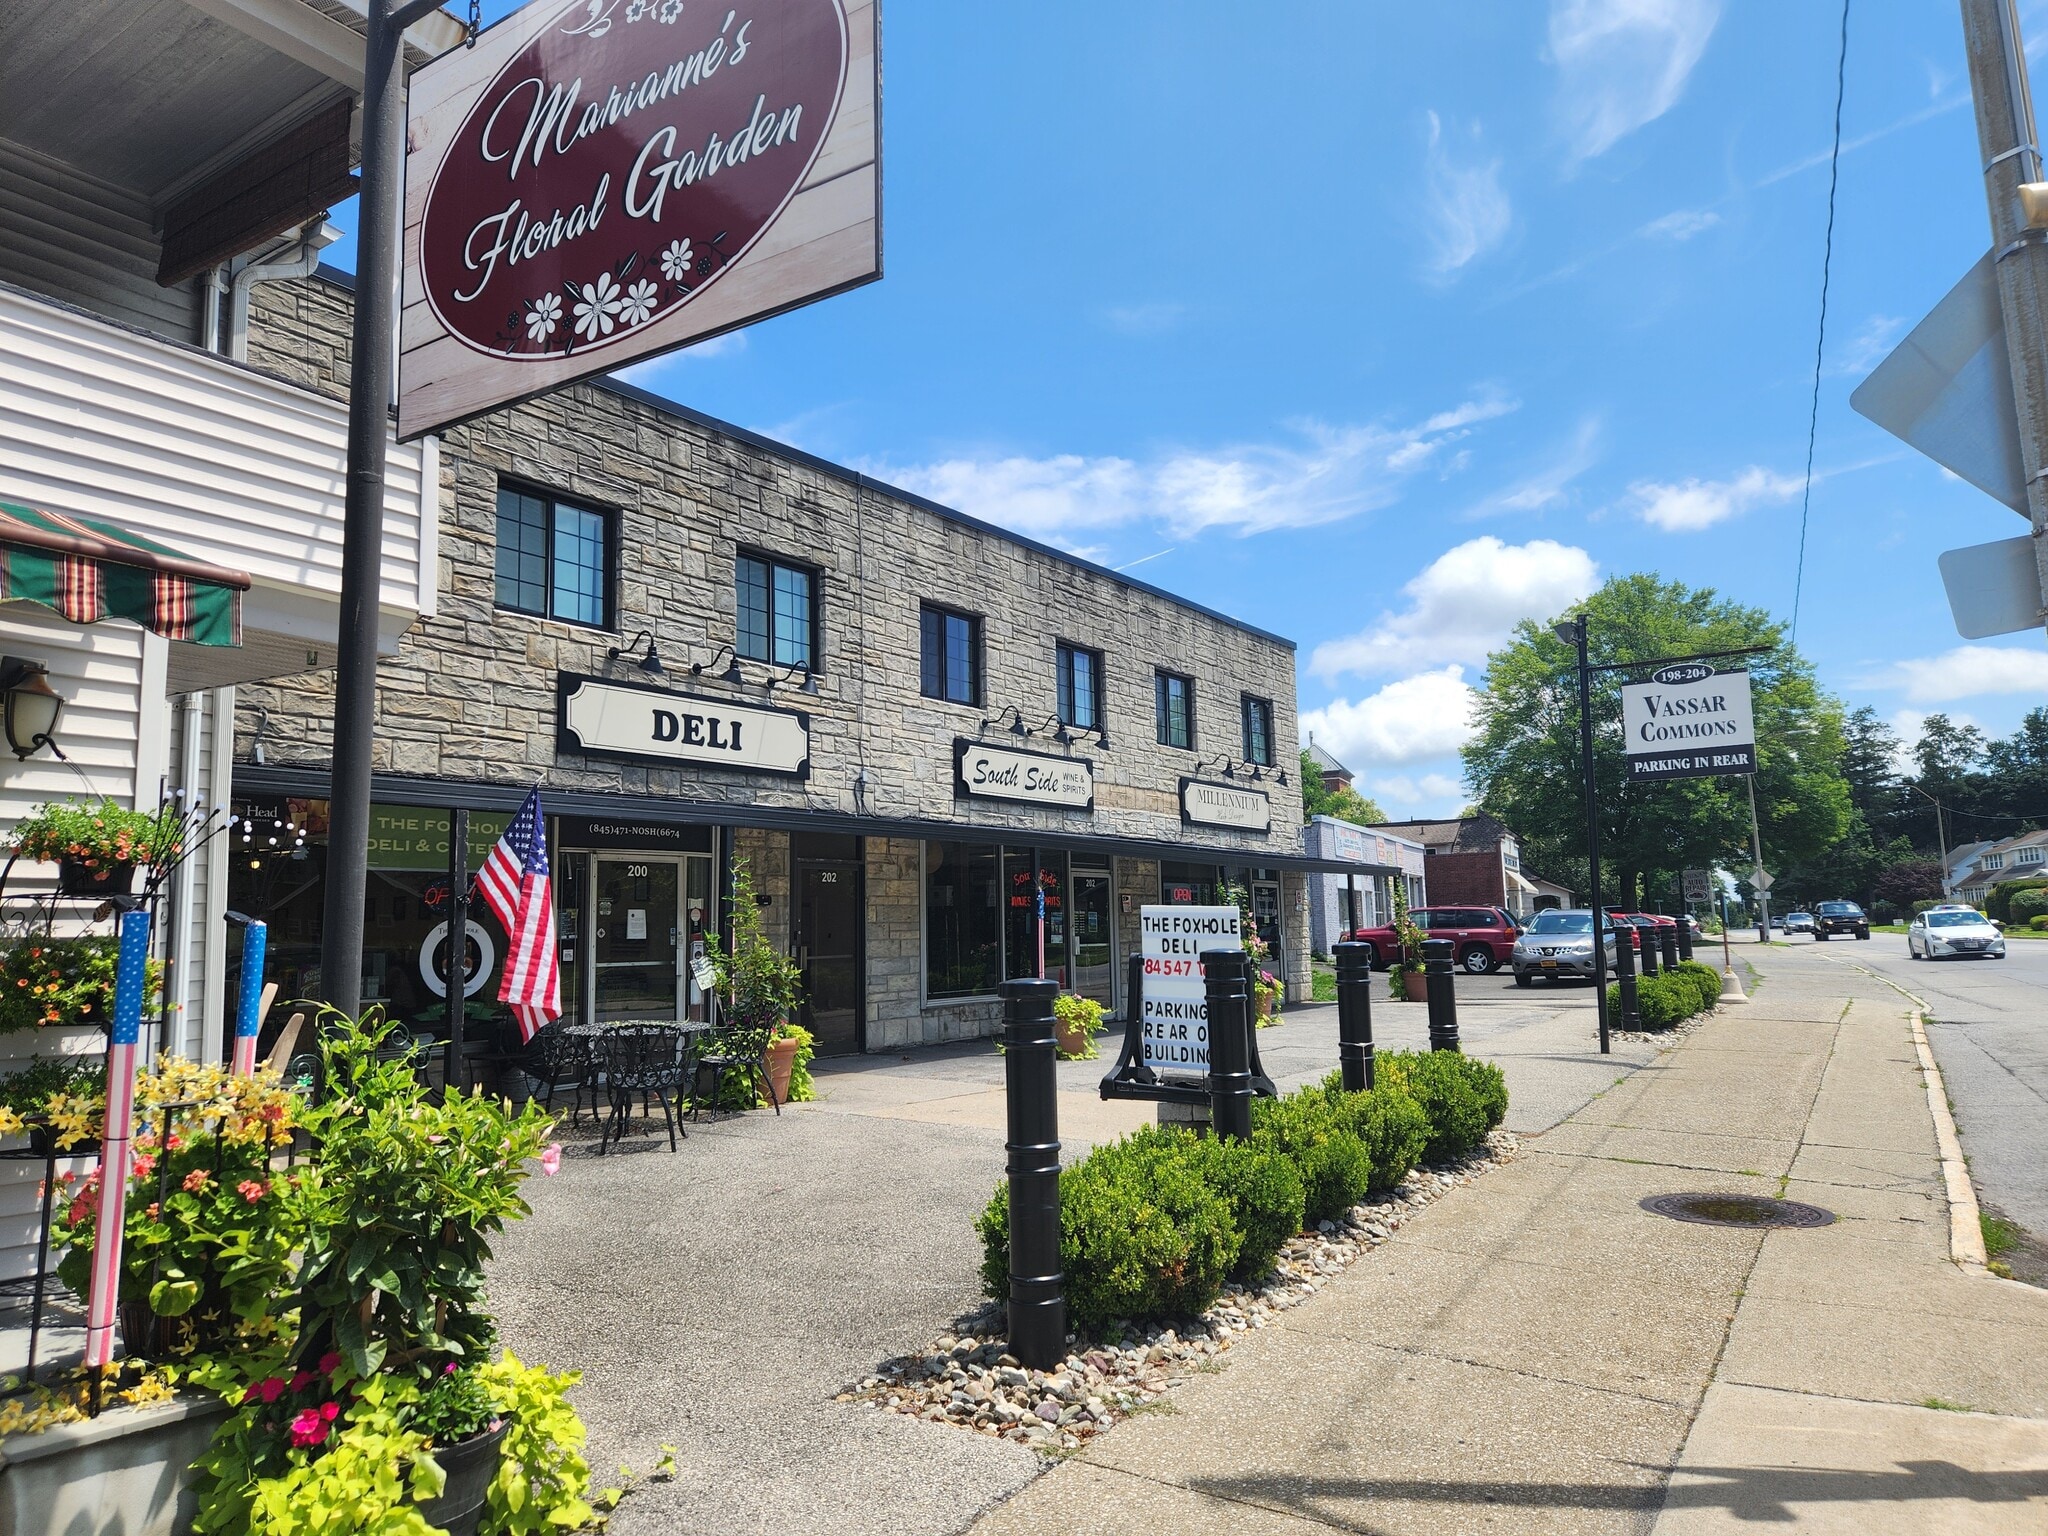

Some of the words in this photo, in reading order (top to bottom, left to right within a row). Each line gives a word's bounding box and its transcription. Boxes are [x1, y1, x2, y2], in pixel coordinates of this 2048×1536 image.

[481, 11, 752, 179] Marianne's
[454, 174, 610, 302] Floral
[625, 94, 803, 222] Garden
[1661, 667, 1707, 682] 198-204
[652, 709, 742, 751] DELI
[1634, 758, 1691, 773] PARKING
[1695, 757, 1709, 768] IN
[1713, 753, 1749, 767] REAR
[973, 759, 1019, 787] South
[1024, 767, 1059, 792] Side
[1062, 772, 1079, 783] WINE
[1080, 775, 1085, 783] &
[1062, 784, 1086, 795] SPIRITS
[1198, 789, 1259, 811] MILLENNIUM
[246, 805, 278, 818] Head
[377, 817, 419, 830] THE
[415, 839, 430, 852] &
[627, 865, 648, 877] 200
[822, 872, 837, 883] 202
[1173, 887, 1192, 901] OPEN
[1143, 916, 1169, 932] THE
[1173, 918, 1238, 935] FOXHOLE
[1162, 938, 1197, 954] DELI
[1145, 1001, 1208, 1020] PARKING
[1145, 1022, 1187, 1040] REAR
